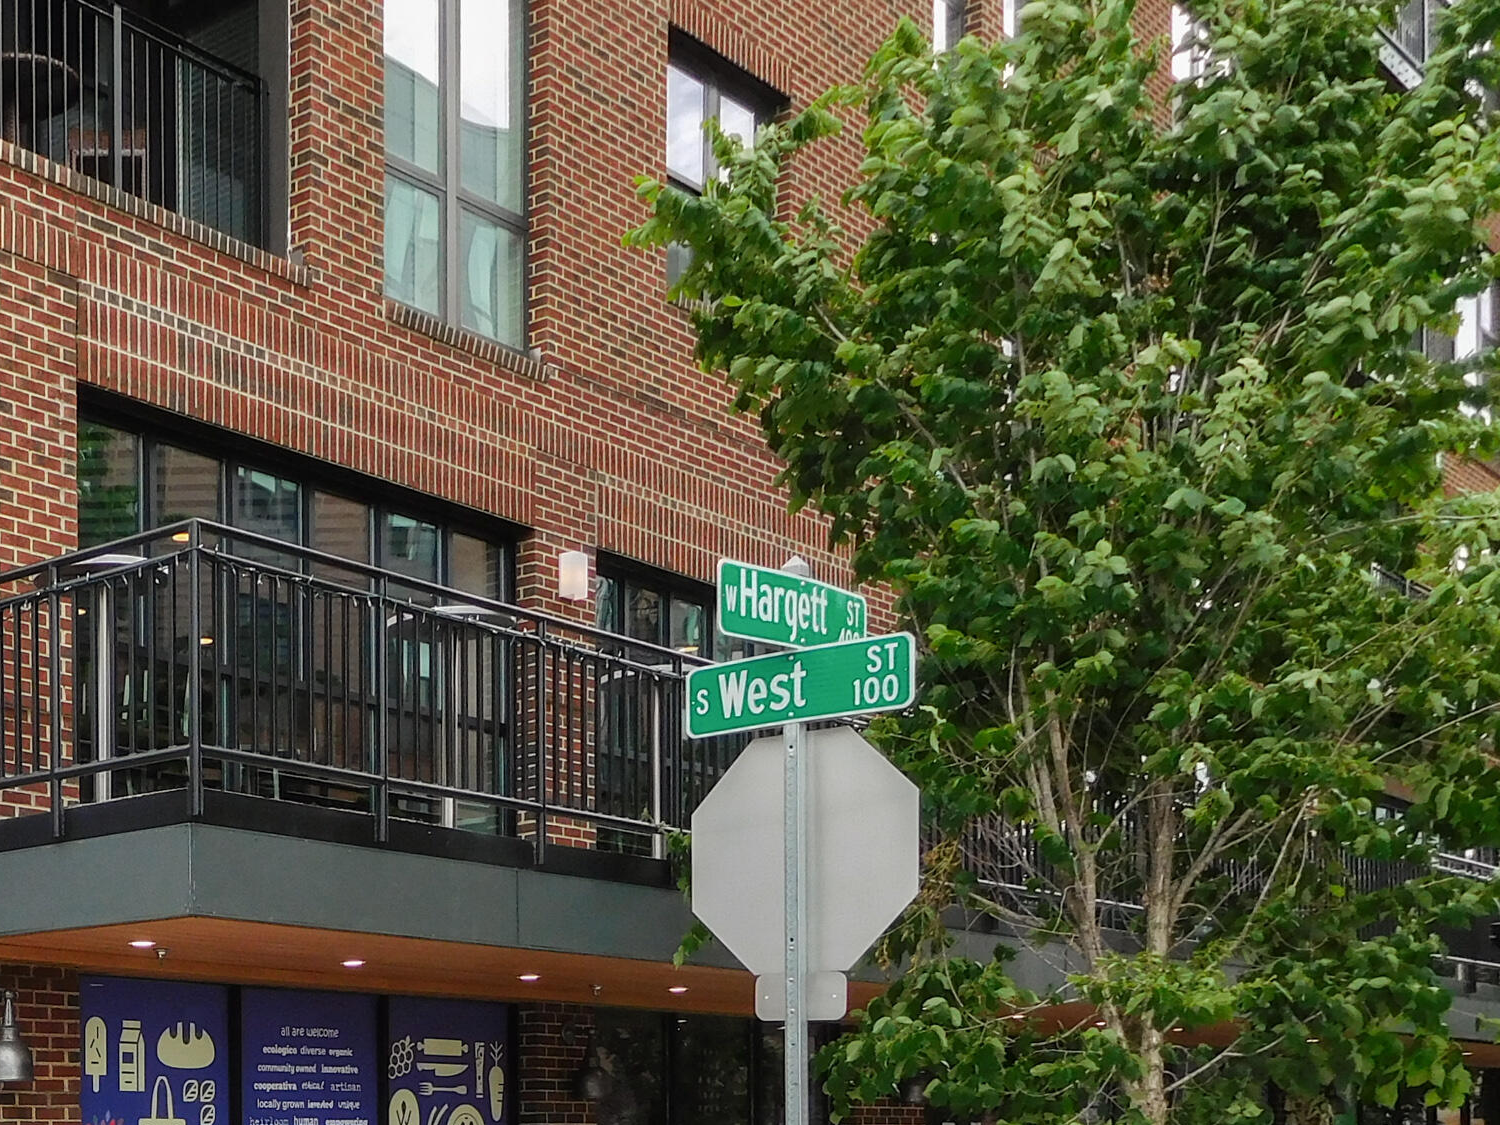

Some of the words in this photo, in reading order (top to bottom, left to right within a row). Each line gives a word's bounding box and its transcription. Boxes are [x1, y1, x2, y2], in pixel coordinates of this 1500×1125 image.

[726, 584, 737, 612] W
[740, 568, 828, 642] Hargett
[847, 601, 860, 627] ST
[696, 689, 709, 715] S
[718, 660, 806, 718] West
[866, 642, 898, 673] ST
[853, 674, 899, 706] 100
[280, 1026, 290, 1037] all
[291, 1027, 304, 1037] are
[306, 1028, 339, 1038] welcome
[300, 1046, 326, 1056] diverse
[329, 1047, 353, 1057] organic
[258, 1063, 295, 1074] community
[296, 1064, 316, 1073] owned
[254, 1081, 297, 1092] cooperativa
[331, 1082, 361, 1092] artisan
[257, 1099, 280, 1110] locally
[282, 1101, 304, 1110] grown
[293, 1116, 318, 1125] human
